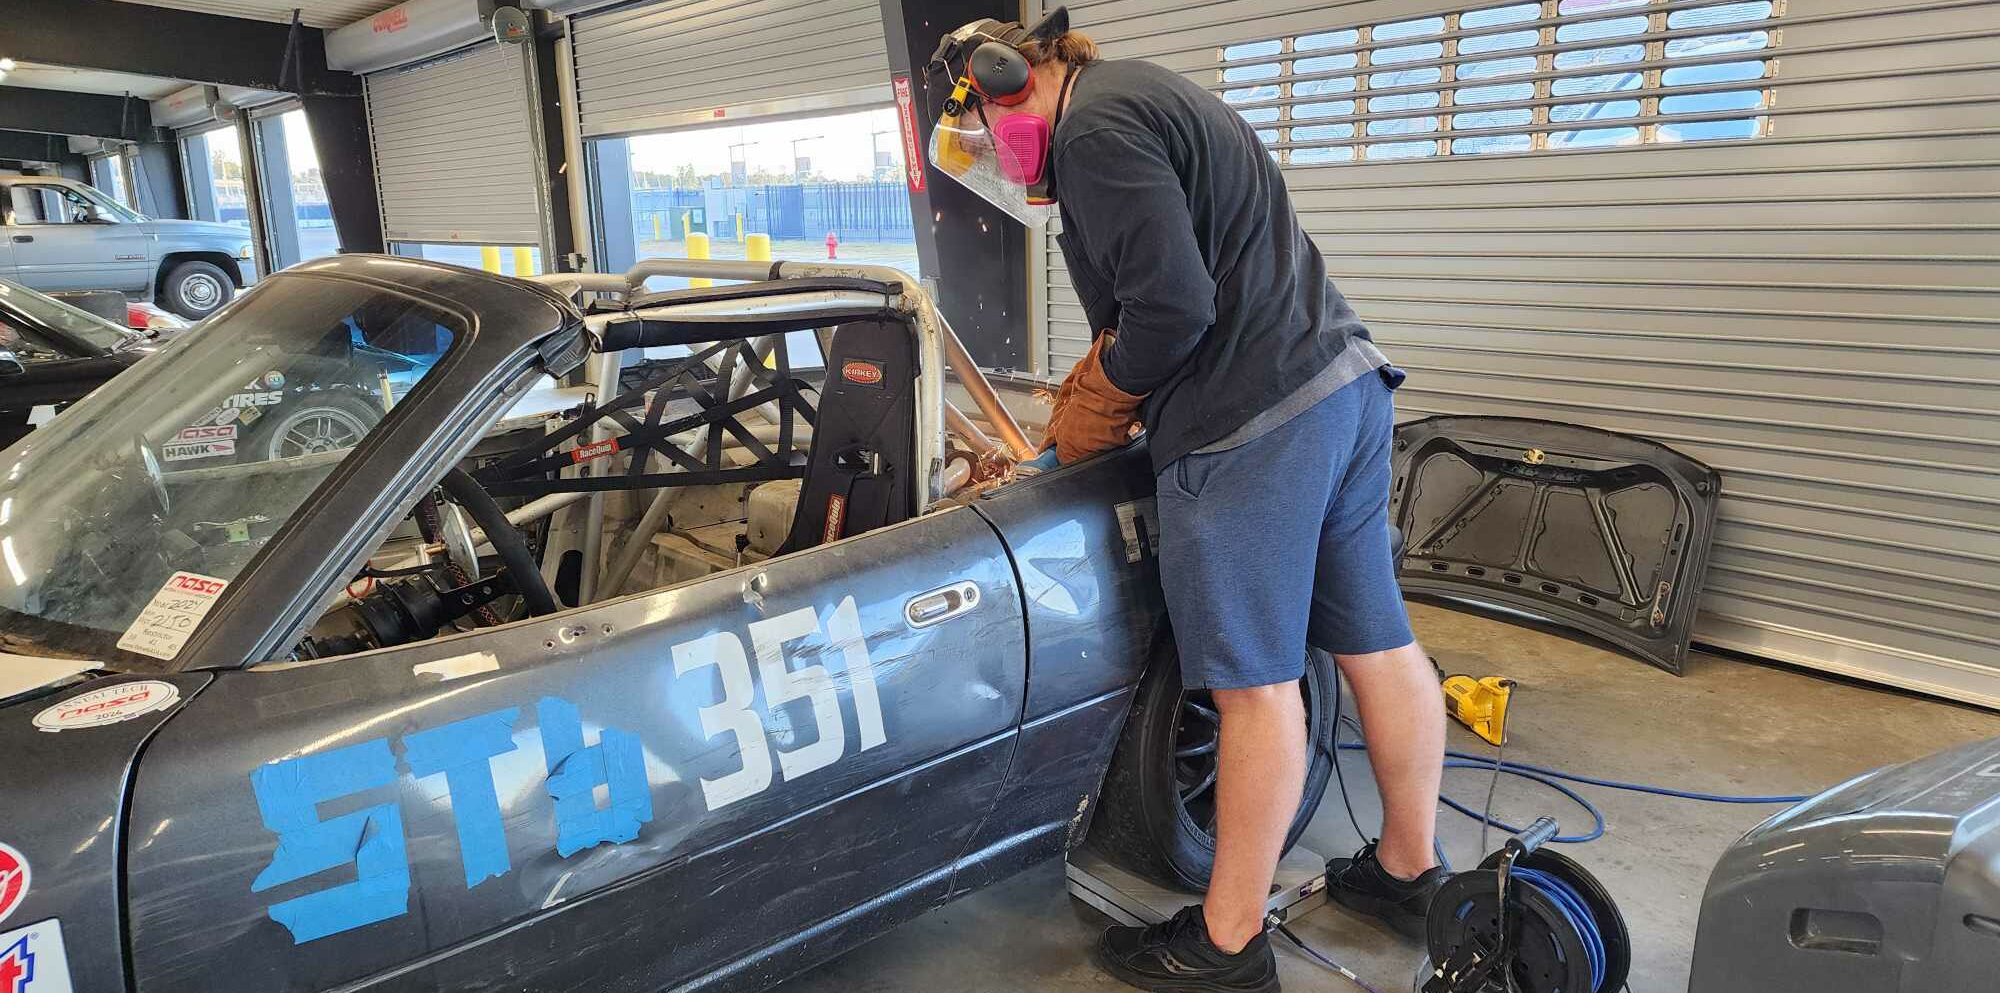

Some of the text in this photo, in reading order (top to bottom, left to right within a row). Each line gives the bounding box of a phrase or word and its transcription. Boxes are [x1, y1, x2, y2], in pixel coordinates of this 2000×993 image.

[165, 444, 210, 458] HAWK
[113, 684, 149, 695] TECH
[671, 595, 887, 811] 351
